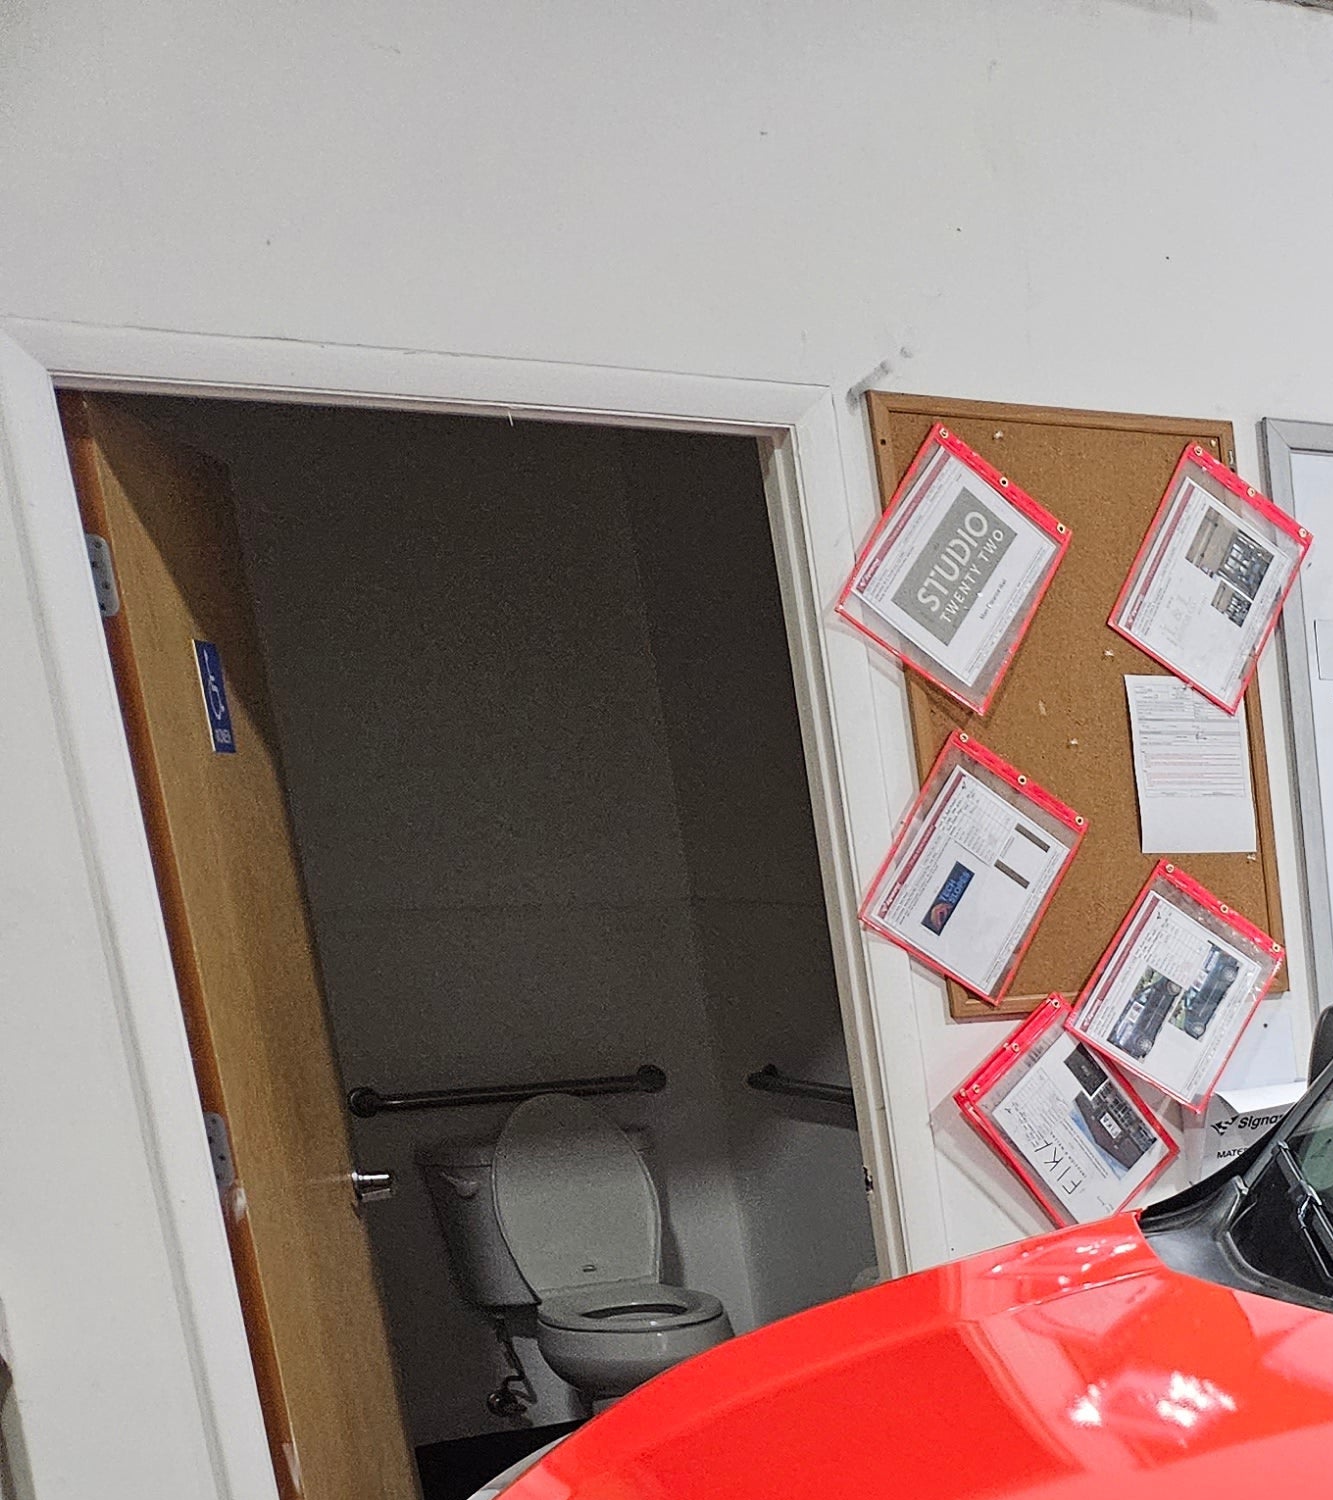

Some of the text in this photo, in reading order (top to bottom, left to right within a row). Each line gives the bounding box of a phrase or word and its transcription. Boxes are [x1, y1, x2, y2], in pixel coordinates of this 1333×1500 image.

[917, 511, 989, 613] STUDIO
[940, 565, 983, 623] TWENTY
[978, 529, 1004, 563] TWO
